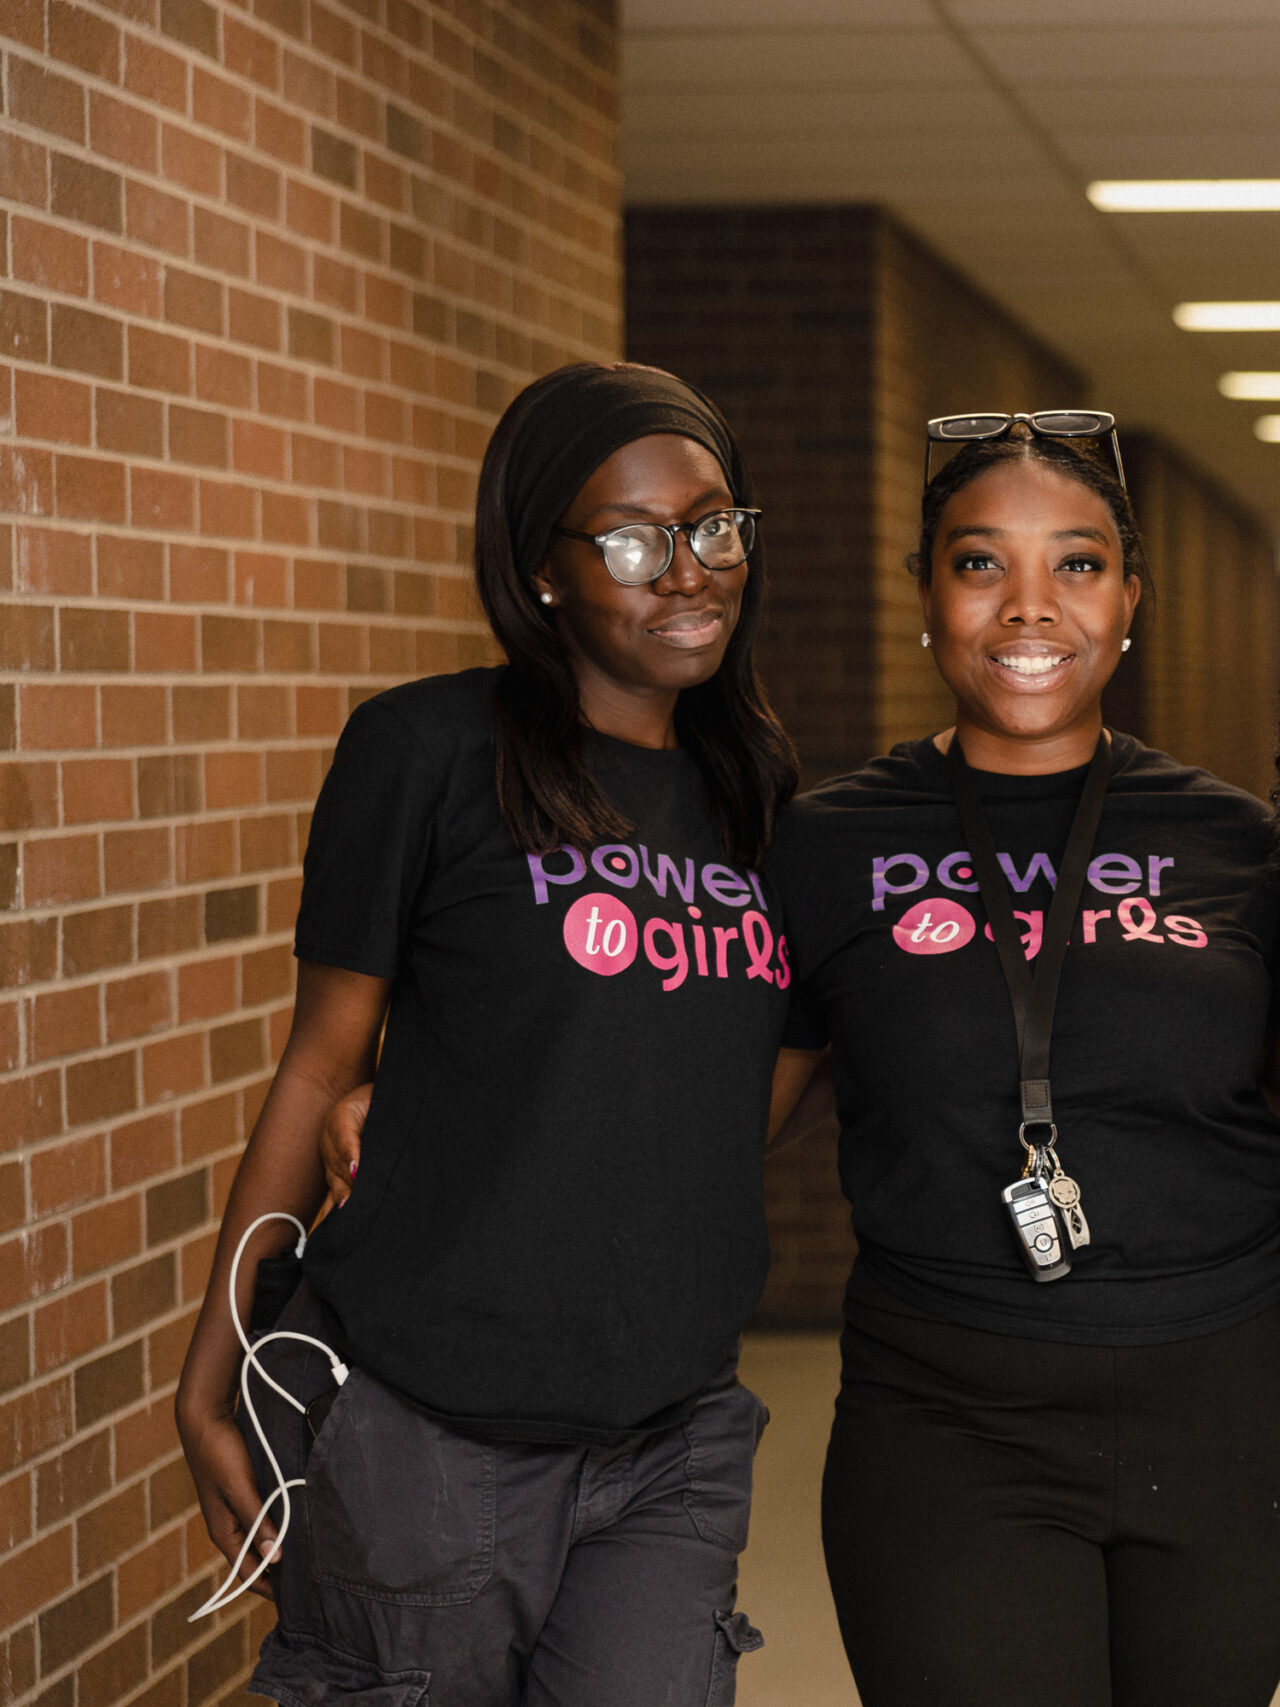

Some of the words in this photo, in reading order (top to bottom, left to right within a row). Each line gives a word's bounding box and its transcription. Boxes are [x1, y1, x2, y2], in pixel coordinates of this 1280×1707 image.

[526, 844, 768, 911] power
[585, 906, 627, 957] to
[643, 906, 791, 992] girls
[910, 912, 960, 944] to
[984, 897, 1208, 961] grls
